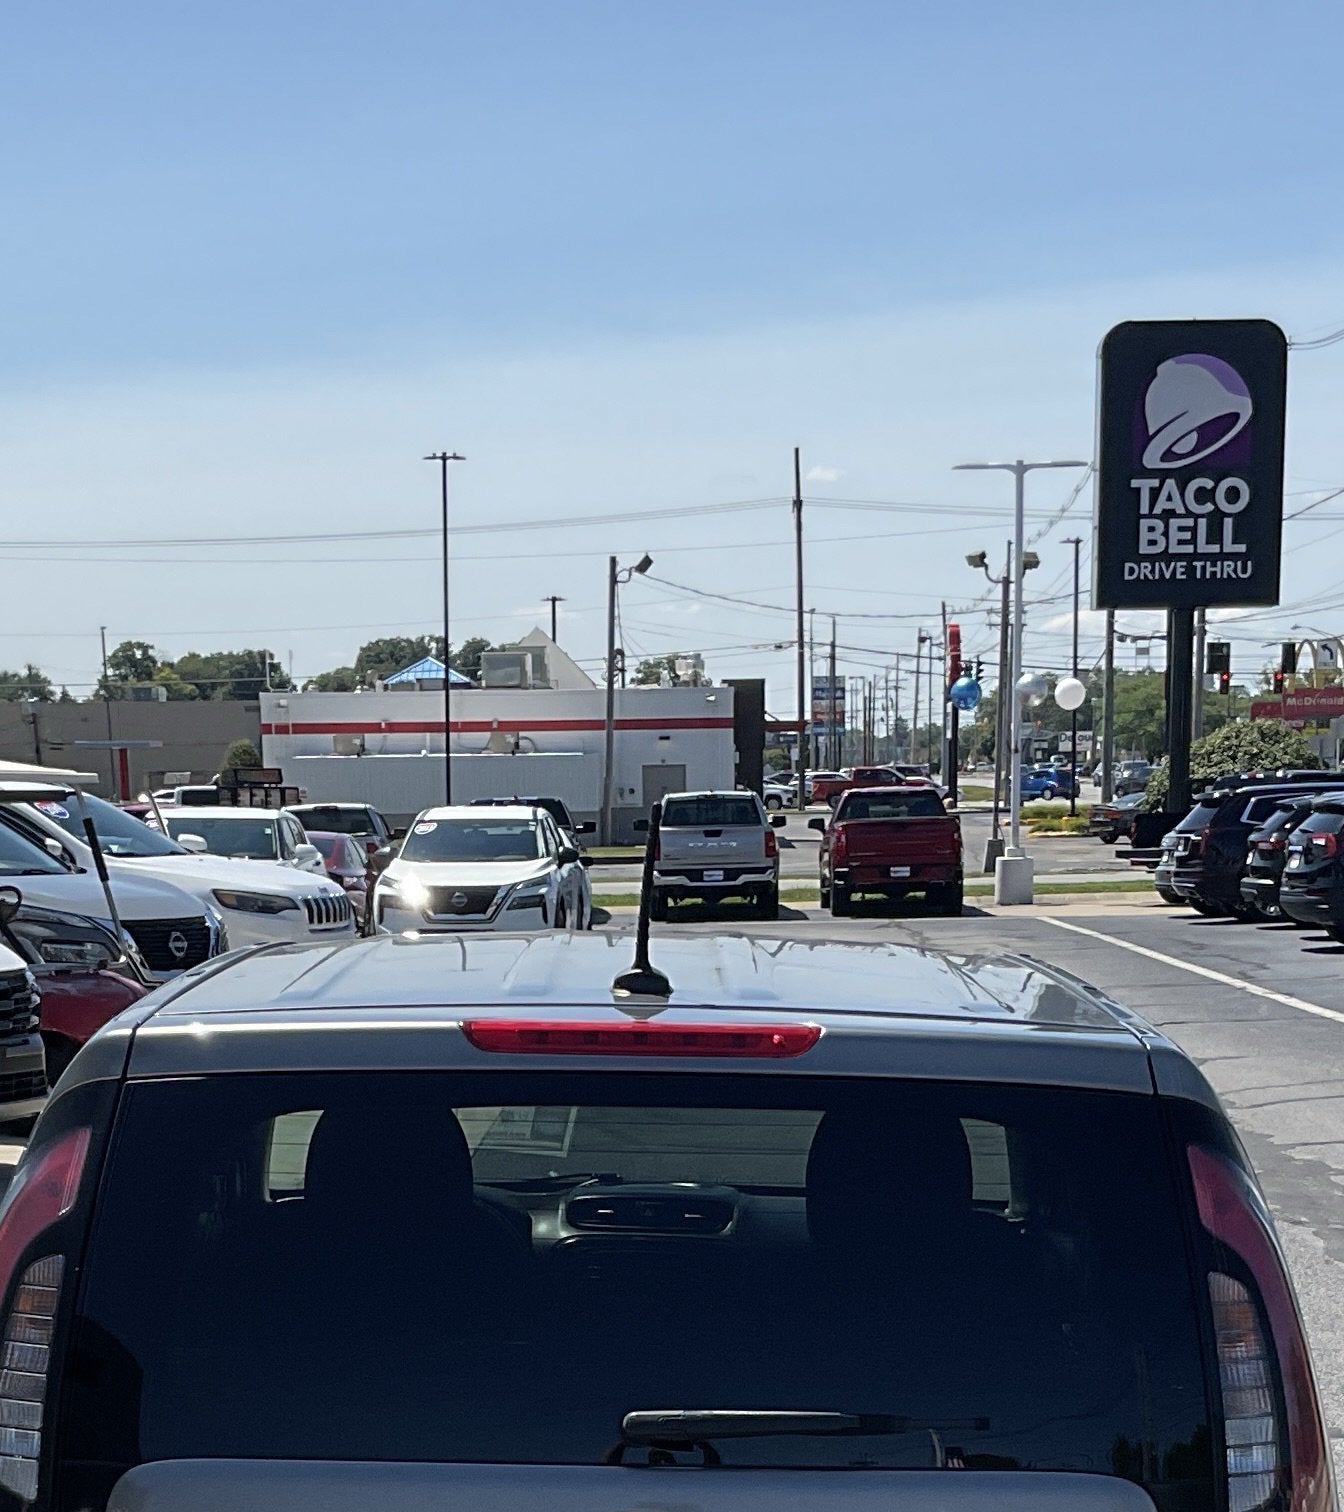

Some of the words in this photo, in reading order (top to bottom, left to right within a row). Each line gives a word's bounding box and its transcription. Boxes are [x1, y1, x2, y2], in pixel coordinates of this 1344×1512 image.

[1130, 477, 1250, 515] TACO
[1138, 517, 1247, 554] BELL
[1123, 561, 1187, 580] DRIVE
[1192, 560, 1253, 579] THRU
